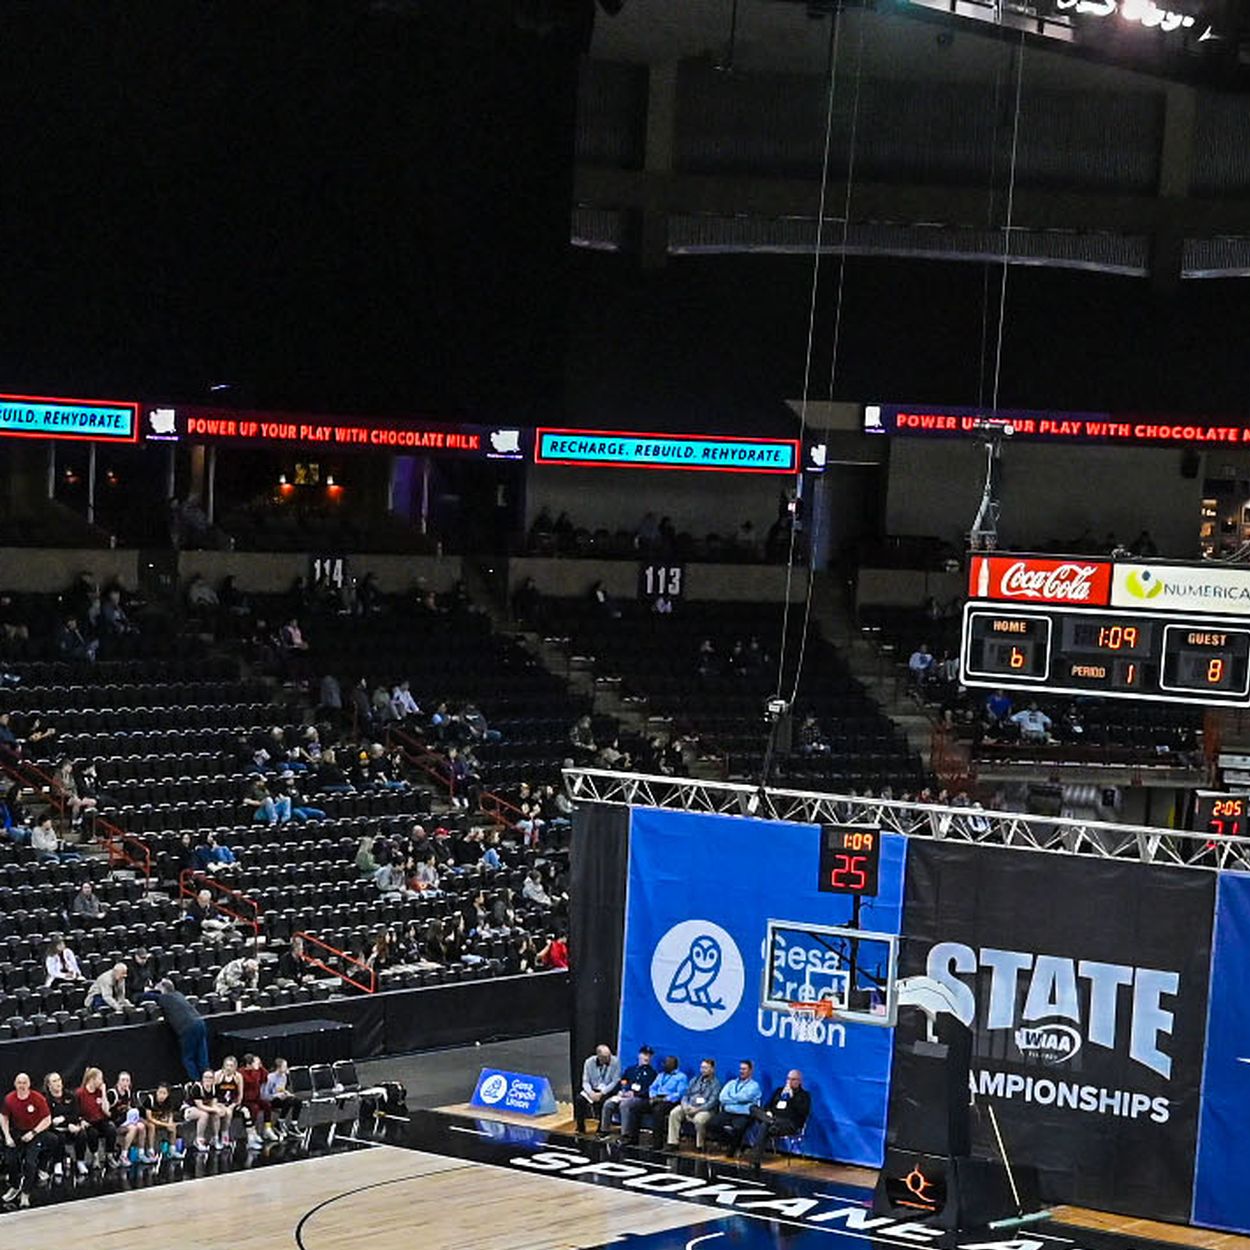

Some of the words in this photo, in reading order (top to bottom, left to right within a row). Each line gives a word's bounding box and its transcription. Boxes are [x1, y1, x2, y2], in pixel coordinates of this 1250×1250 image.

[43, 410, 125, 429] REHYDRATE.
[897, 413, 956, 430] POWER
[1039, 420, 1081, 435] PLAY
[1086, 422, 1119, 437] WITH
[1134, 424, 1239, 442] CHOCOLATE
[187, 417, 235, 436] POWER
[238, 420, 257, 437] UP
[261, 421, 297, 440] YOUR
[300, 424, 332, 441] PLAY
[335, 427, 367, 444] WITH
[371, 429, 444, 448] CHOCOLATE
[446, 433, 479, 450] MILK
[550, 440, 629, 457] RECHARGE.
[634, 444, 697, 460] REBUILD.
[702, 447, 785, 463] REHYDRATE.
[645, 565, 682, 596] 113
[994, 620, 1027, 634] HOME
[1098, 625, 1138, 650] 1:09
[1187, 633, 1227, 647] GUEST
[1071, 665, 1106, 678] PERIOD
[1126, 664, 1134, 684] 1
[1207, 659, 1222, 682] 8
[1213, 801, 1243, 817] 2:05
[844, 832, 873, 851] 1:09
[831, 853, 868, 889] 25
[761, 934, 840, 972] Gesa
[927, 941, 1180, 1081] STATE
[1025, 1029, 1071, 1052] WIAA
[969, 1069, 1170, 1124] AMPIONSHIPS
[511, 1151, 947, 1243] SPOKANE
